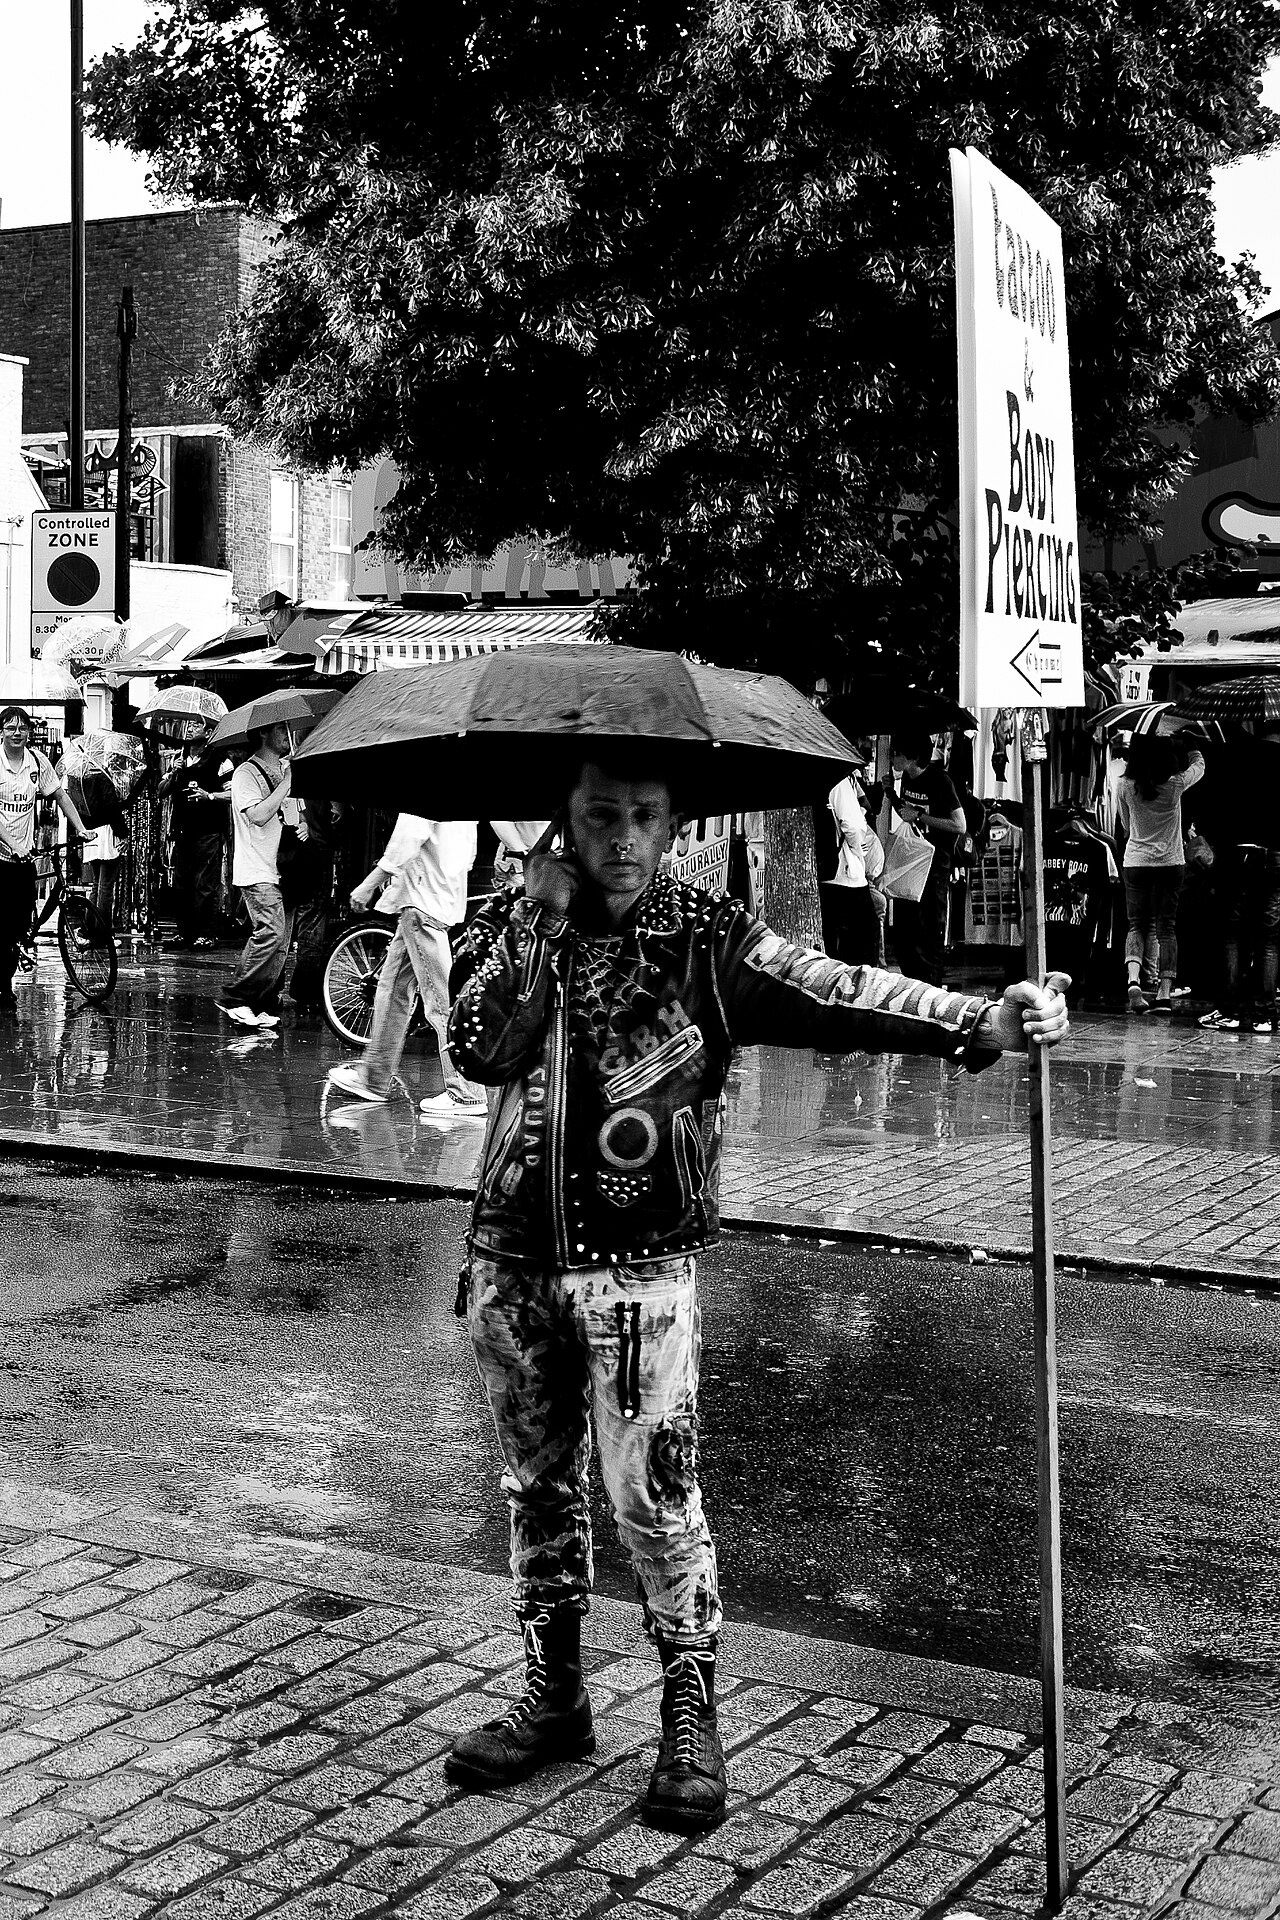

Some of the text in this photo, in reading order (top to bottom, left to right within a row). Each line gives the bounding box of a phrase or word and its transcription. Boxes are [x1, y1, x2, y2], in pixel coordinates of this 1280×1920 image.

[38, 517, 110, 529] Controlled
[48, 533, 99, 547] ZONE
[14, 793, 27, 801] Fly
[673, 841, 726, 880] NATURALLY
[1042, 858, 1089, 873] ABBEY ROAD
